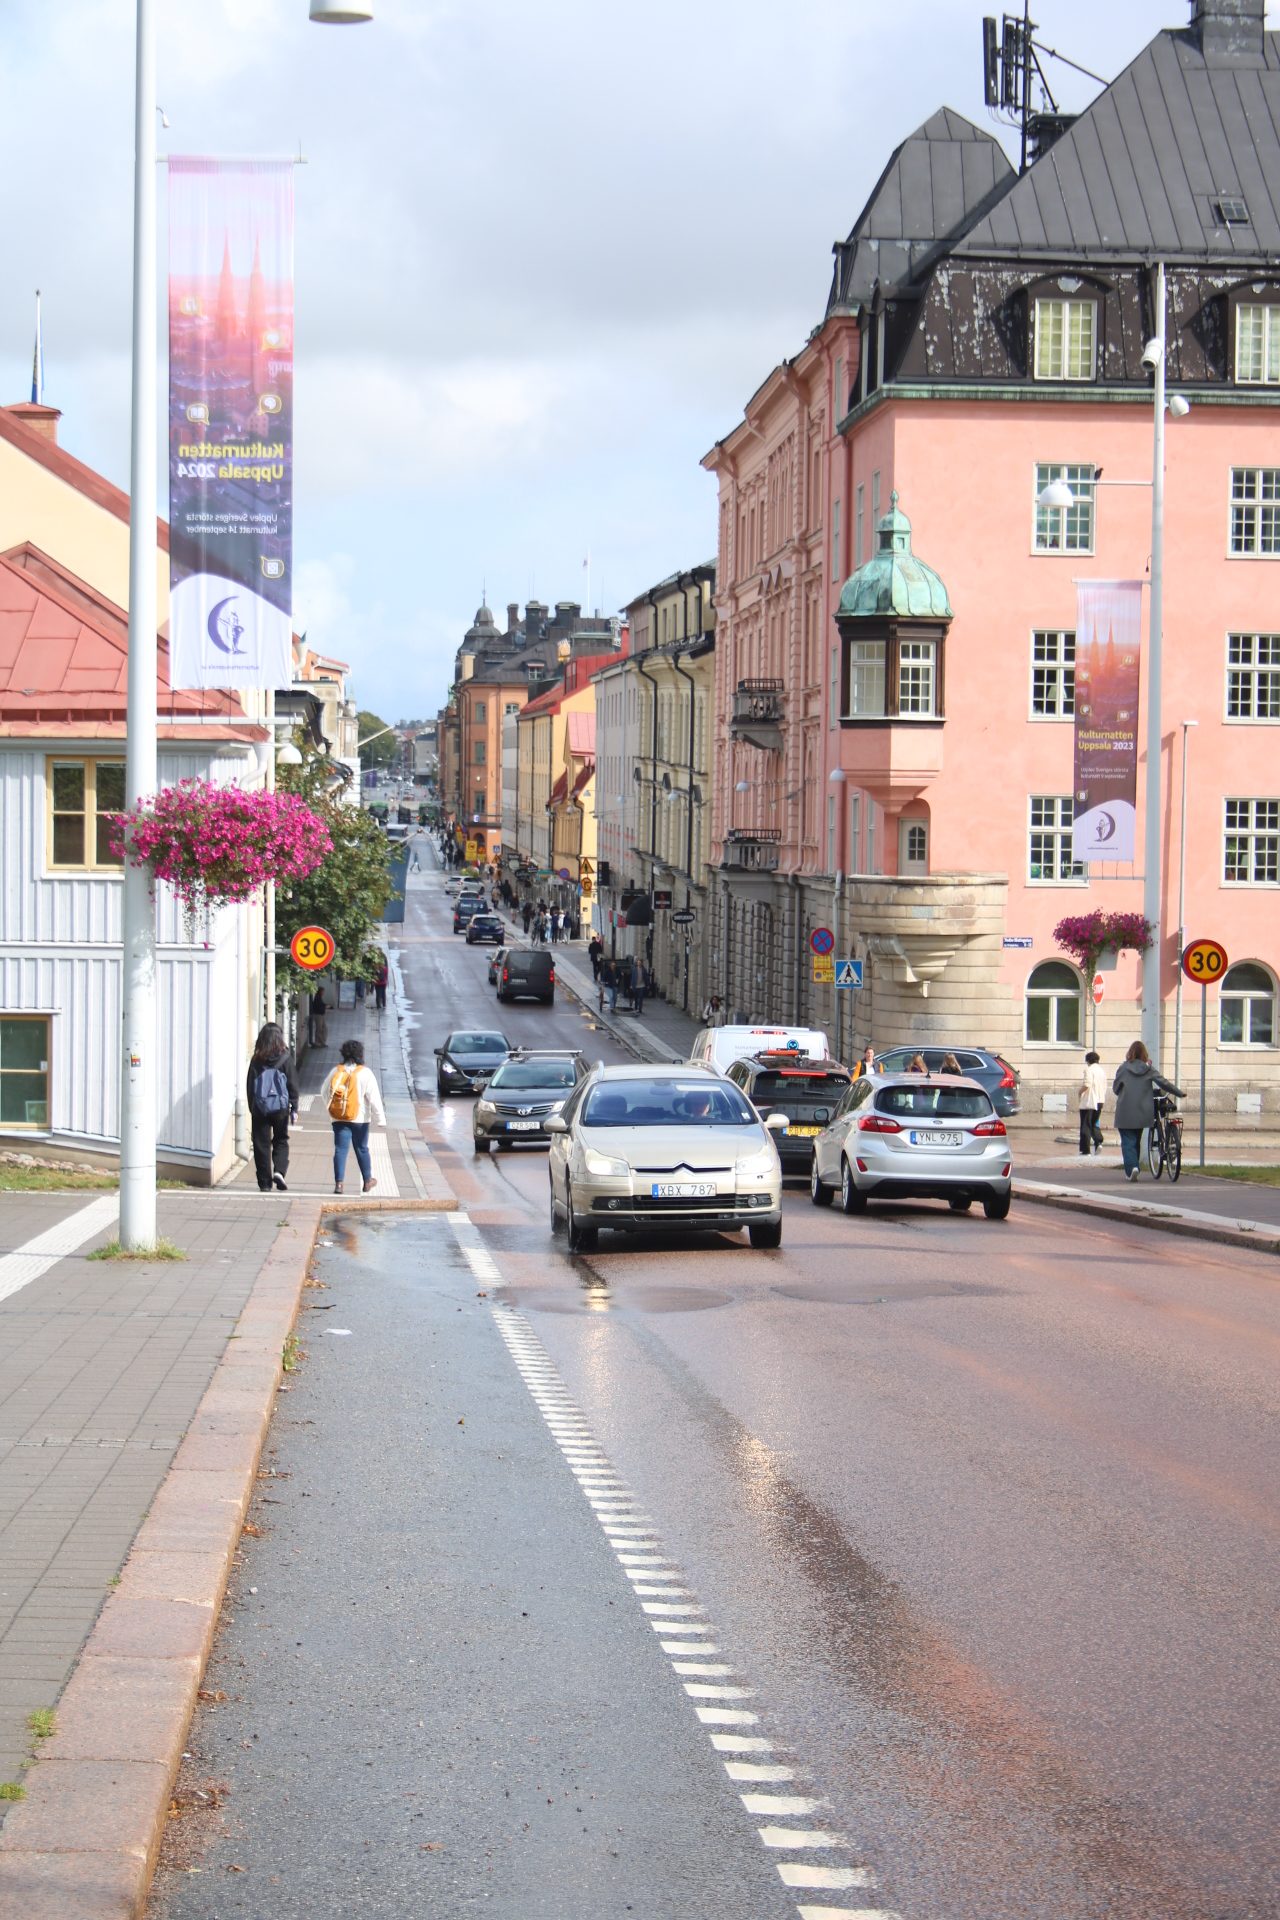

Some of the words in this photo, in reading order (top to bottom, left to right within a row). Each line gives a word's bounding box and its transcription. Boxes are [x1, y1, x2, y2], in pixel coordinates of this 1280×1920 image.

[1078, 730, 1134, 740] Kulturnatten
[1078, 741, 1112, 751] Uppsala
[1112, 741, 1134, 750] 2023
[299, 938, 328, 958] 30
[1192, 951, 1222, 973] 30
[919, 1133, 937, 1142] YNL
[940, 1133, 958, 1143] 975
[660, 1185, 682, 1196] XBX
[691, 1184, 713, 1196] 787
